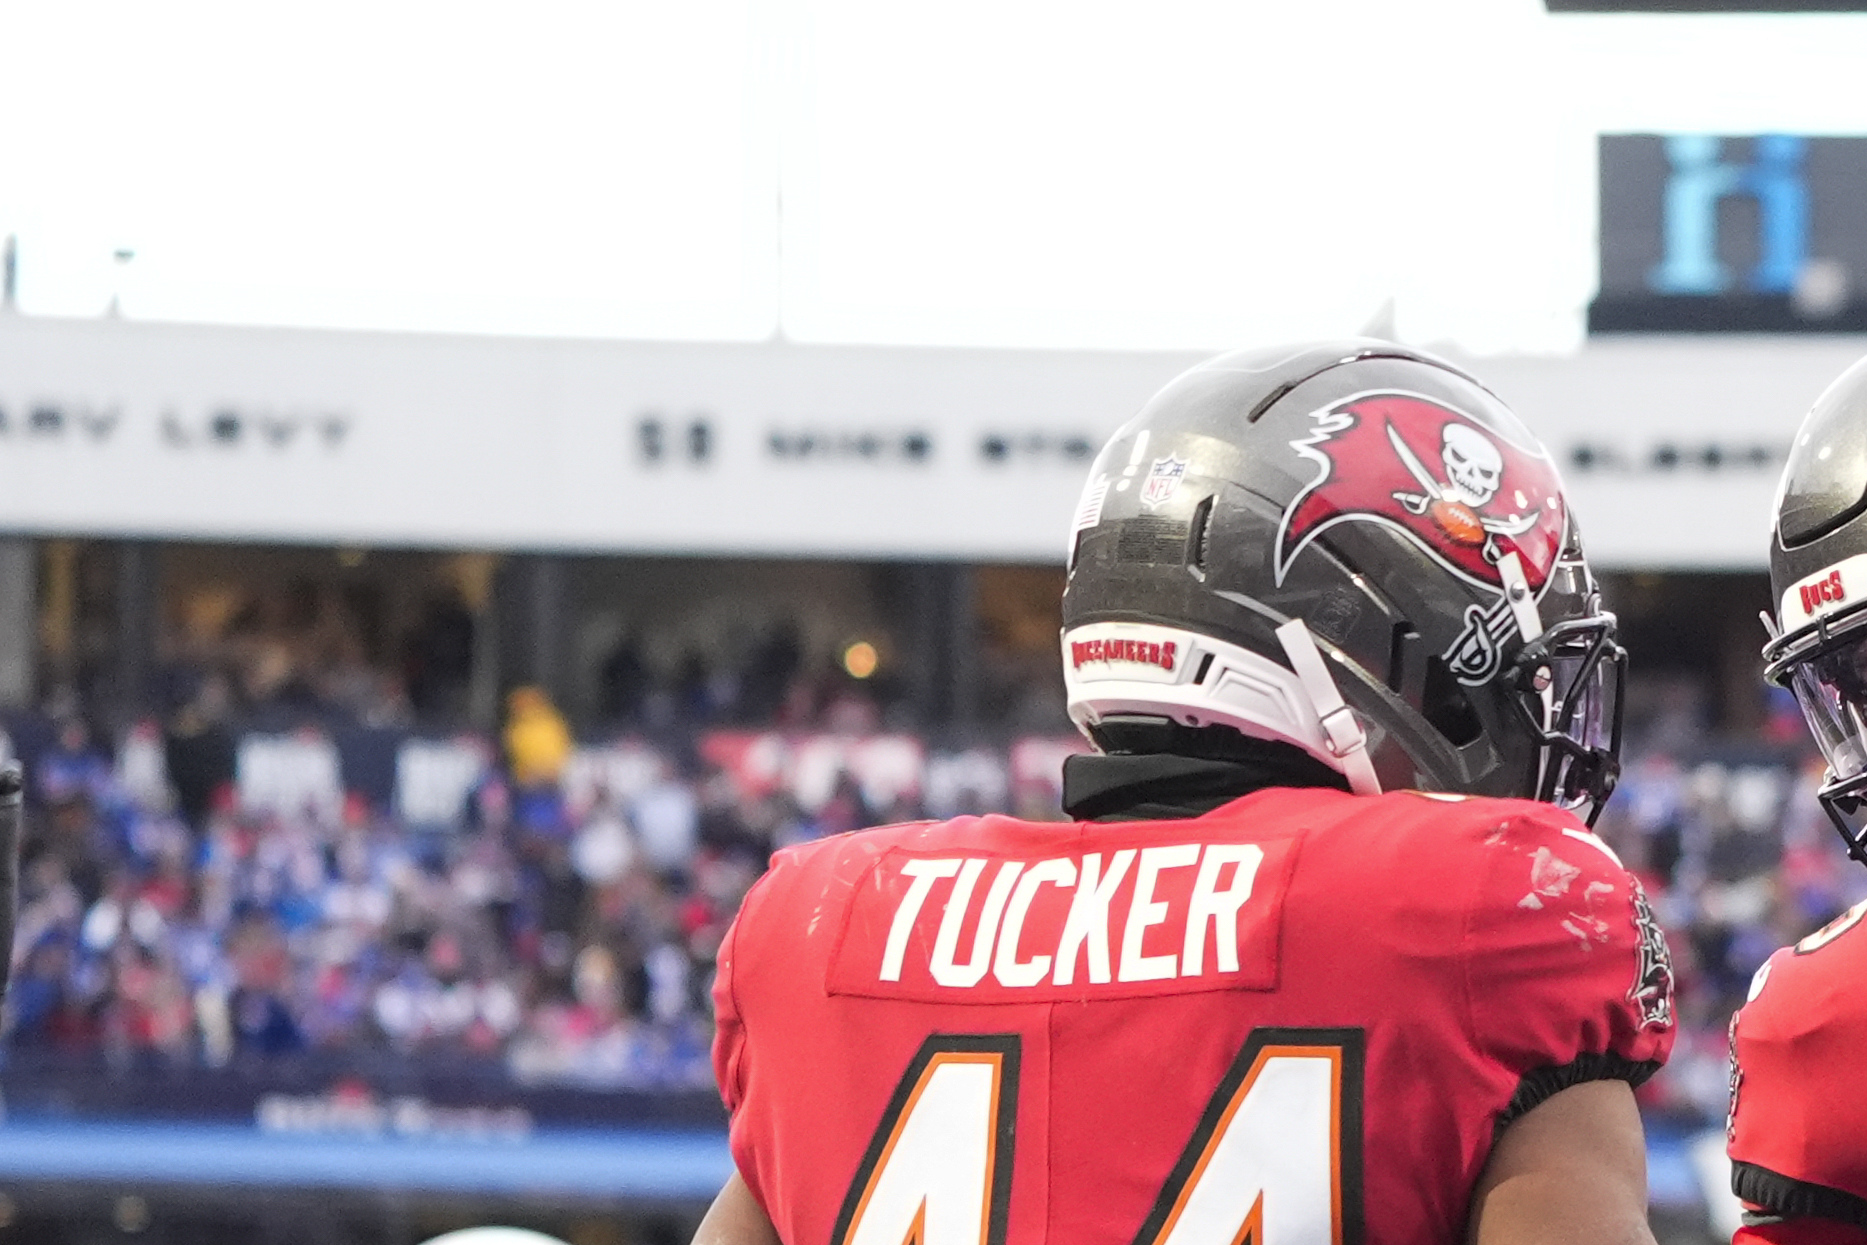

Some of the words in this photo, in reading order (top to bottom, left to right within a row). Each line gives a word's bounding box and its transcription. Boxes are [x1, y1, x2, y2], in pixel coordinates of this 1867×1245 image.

[1144, 477, 1174, 497] NFL
[1799, 569, 1845, 615] BUCS
[878, 843, 1264, 989] TUCKER
